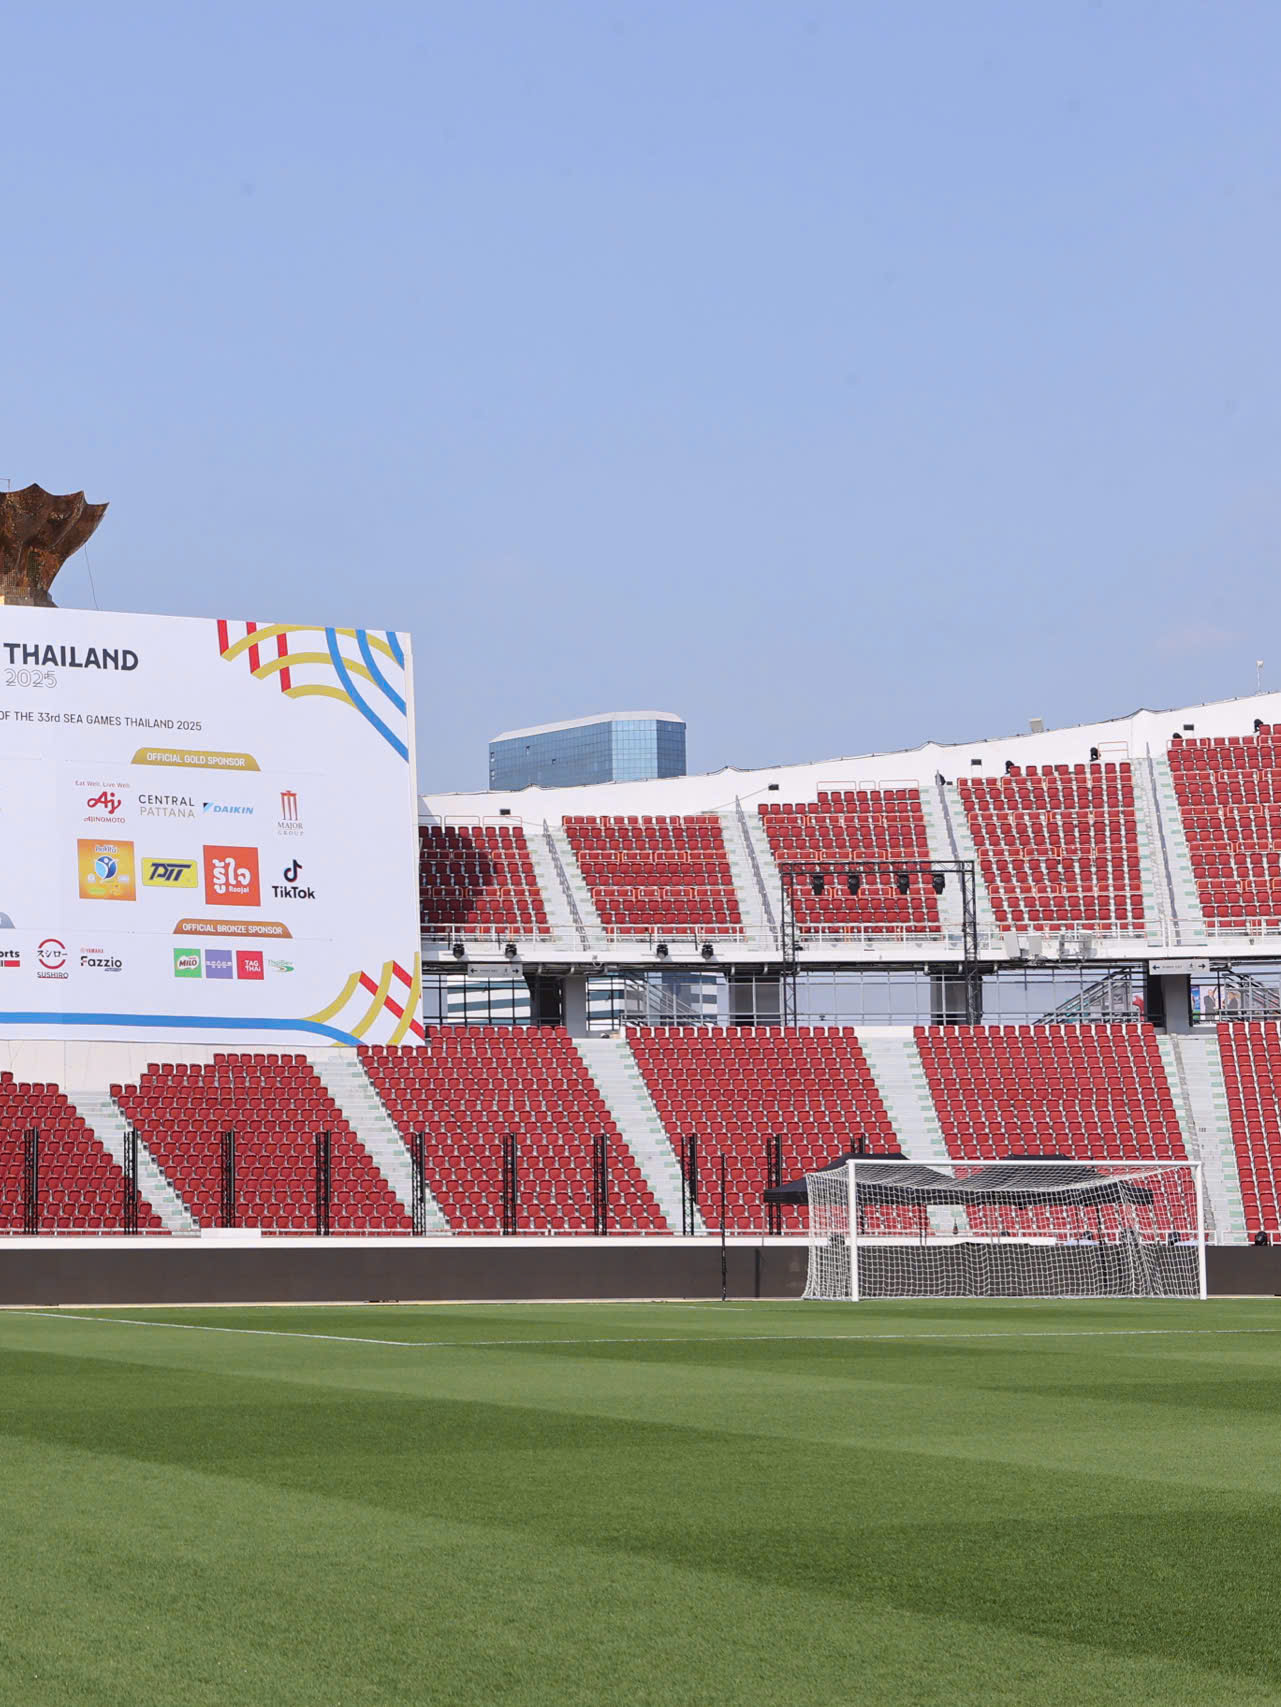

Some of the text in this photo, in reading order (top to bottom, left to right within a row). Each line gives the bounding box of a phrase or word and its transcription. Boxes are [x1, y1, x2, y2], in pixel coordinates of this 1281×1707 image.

[3, 642, 139, 671] THAILAND
[4, 668, 58, 688] 2025
[14, 711, 35, 722] THE
[37, 712, 61, 723] 33rd
[63, 713, 84, 724] SEA
[86, 714, 121, 726] GAMES
[125, 716, 174, 729] THAILAND
[177, 720, 202, 731] 2025
[147, 752, 246, 767] OFFICIAL GOLD SPONSOR
[138, 794, 195, 807] CENTRAL
[140, 806, 196, 819] PATTANA
[213, 804, 254, 815] DAIKIN
[83, 816, 126, 824] AJINOMOTO
[278, 821, 304, 830] MAJOR
[272, 885, 316, 900] TikTok
[182, 922, 283, 935] OFFICIAL BRONZE SPONSOR
[36, 950, 69, 958] スシロー
[80, 955, 123, 968] Fazzio
[179, 959, 198, 967] MILO
[36, 971, 70, 979] SUSHIRO
